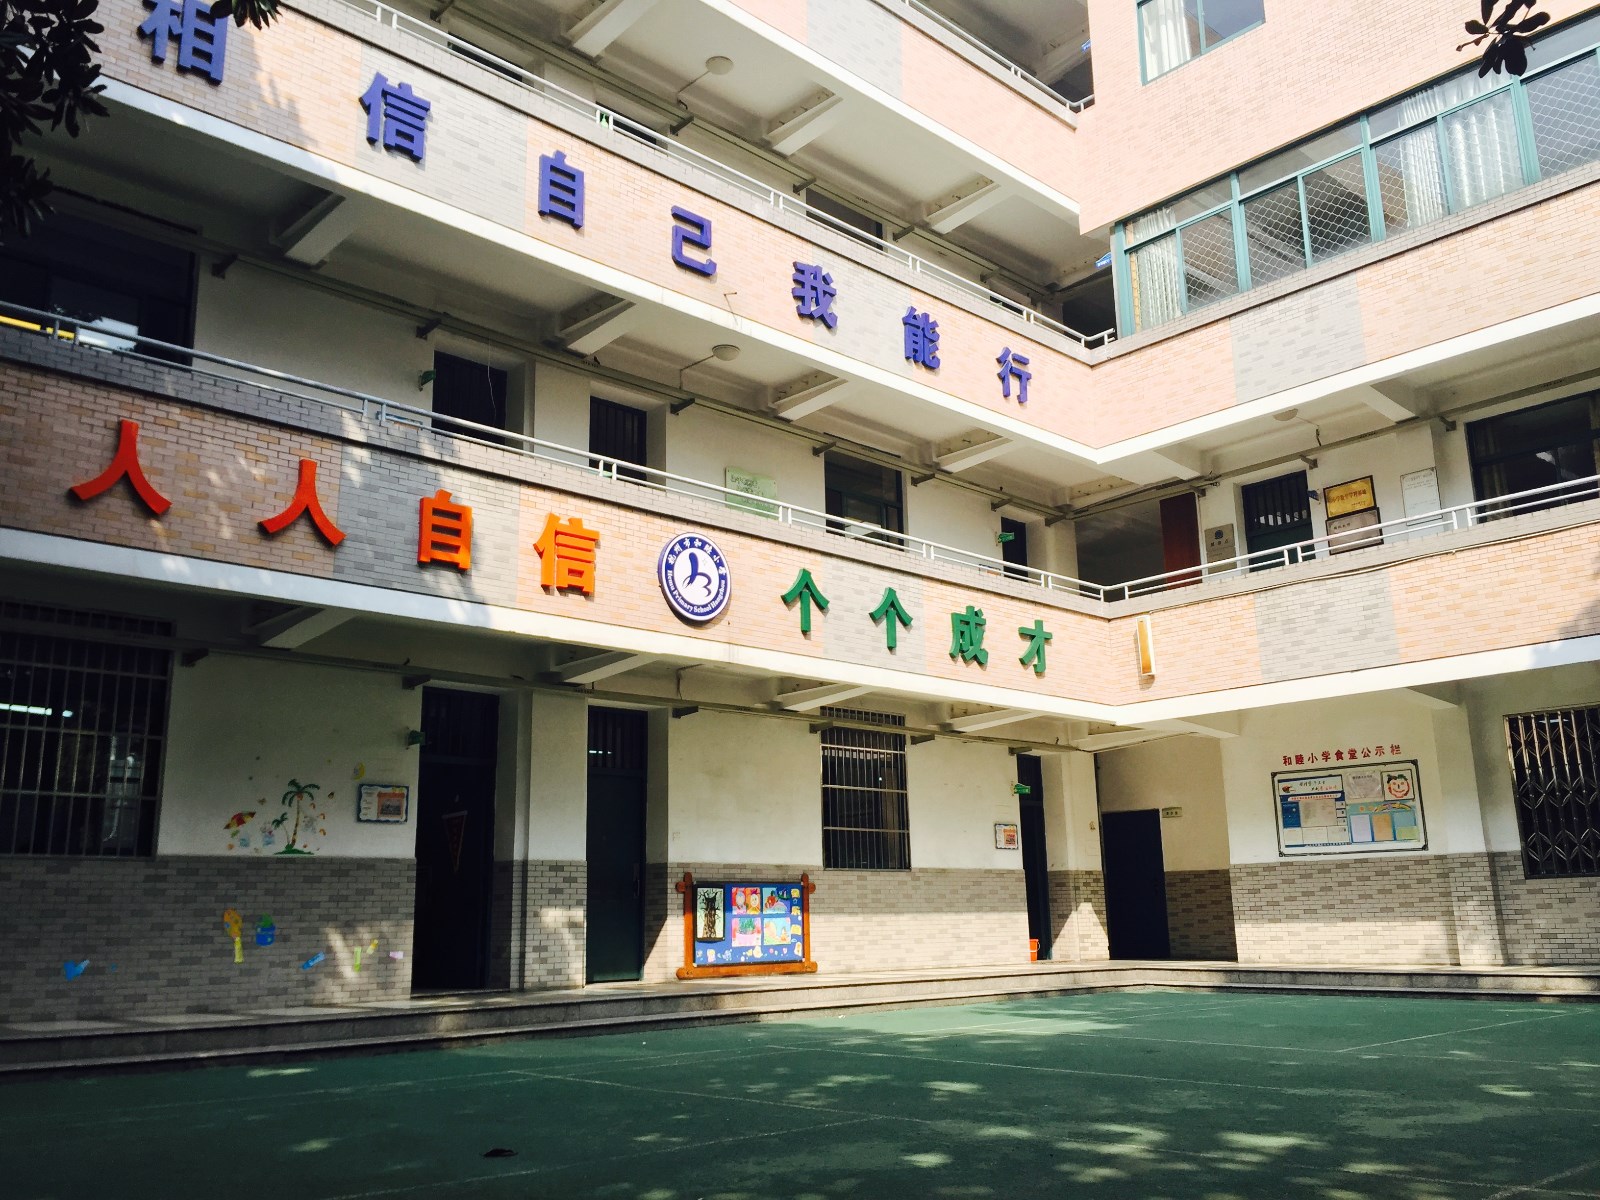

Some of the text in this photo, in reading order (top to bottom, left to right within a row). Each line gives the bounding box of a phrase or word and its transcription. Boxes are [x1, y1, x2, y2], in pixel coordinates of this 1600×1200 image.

[137, 0, 1032, 403] 相信自己我能行
[69, 419, 1053, 674] 人人自信 个个成才
[673, 589, 694, 612] Primary
[693, 603, 712, 614] School
[1282, 743, 1402, 766] 和睦小学食堂公示栏
